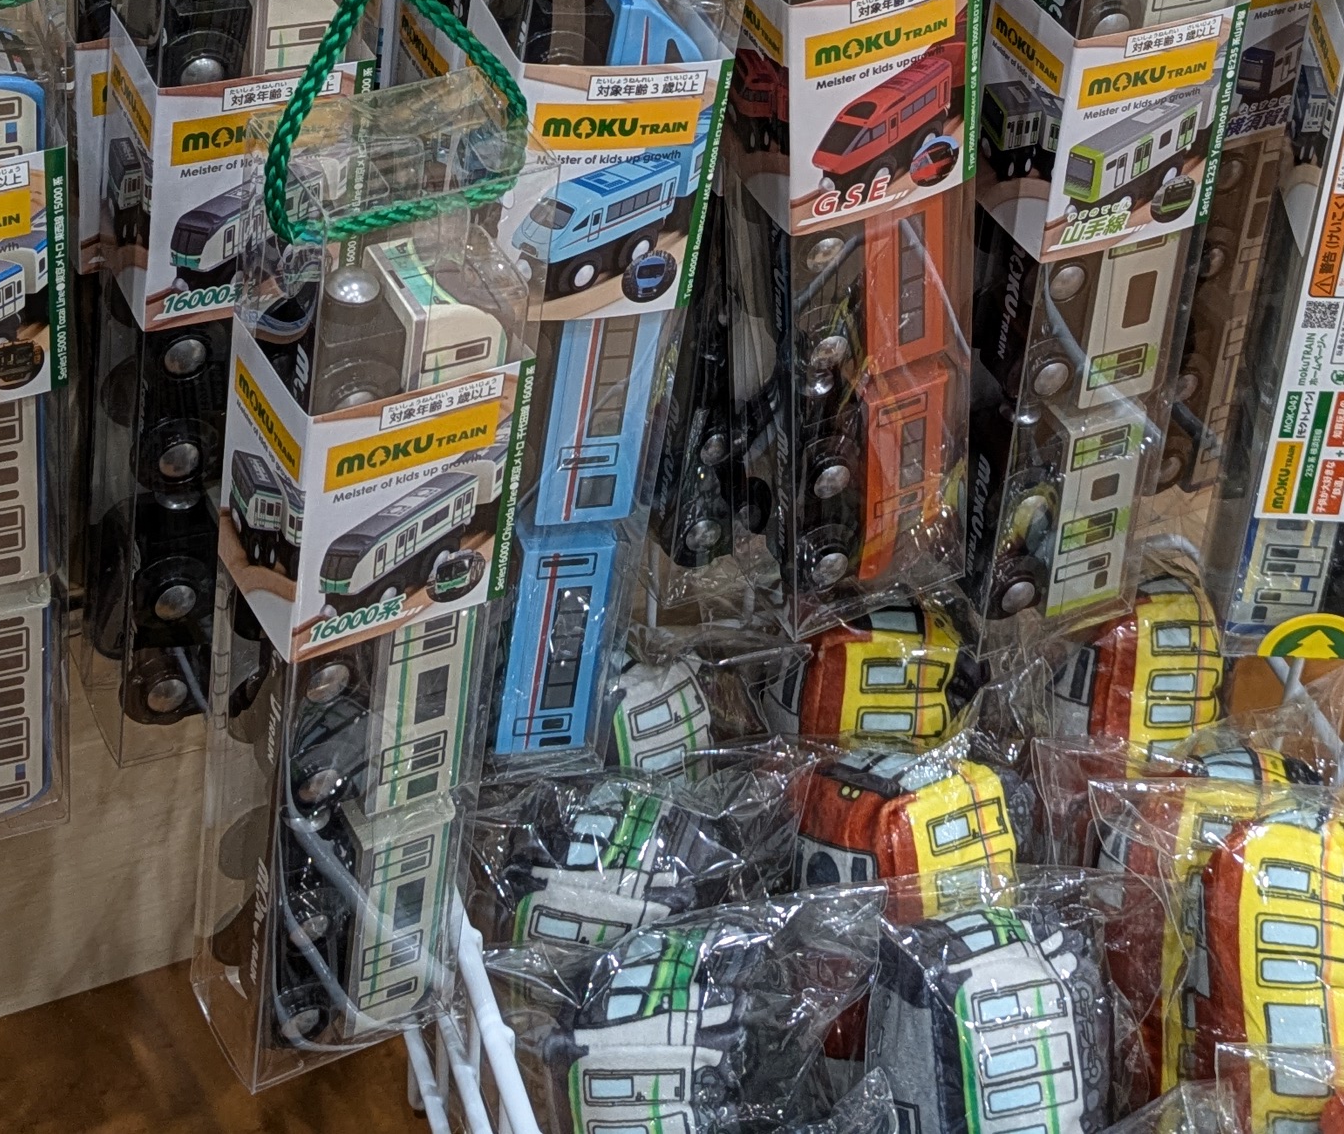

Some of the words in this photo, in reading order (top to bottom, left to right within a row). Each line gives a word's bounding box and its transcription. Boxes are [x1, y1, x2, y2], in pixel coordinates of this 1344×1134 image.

[815, 27, 902, 66] MOKU
[904, 18, 947, 40] TRAIN
[1088, 66, 1167, 96] MOKU
[1167, 62, 1206, 79] TRAIN
[1221, 81, 1232, 103] Line
[1083, 106, 1119, 120] Meister
[1121, 102, 1131, 112] of
[1134, 99, 1151, 111] kids
[1154, 96, 1167, 106] up
[1169, 87, 1200, 102] growth
[542, 117, 639, 138] MOKU
[640, 121, 688, 136] TRAIN
[1210, 109, 1228, 157] Yamanote
[180, 165, 223, 179] Meister
[1205, 158, 1218, 184] E235
[1199, 186, 1212, 216] Series
[56, 306, 65, 331] Tozai
[1295, 332, 1317, 385] mokuTRAIN
[1282, 394, 1299, 432] MOK-042
[336, 433, 434, 477] MOKU
[436, 425, 487, 447] TRAIN
[333, 483, 378, 503] Meister
[381, 478, 393, 490] of
[396, 471, 420, 485] kids
[423, 466, 438, 478] up
[441, 454, 482, 473] growth
